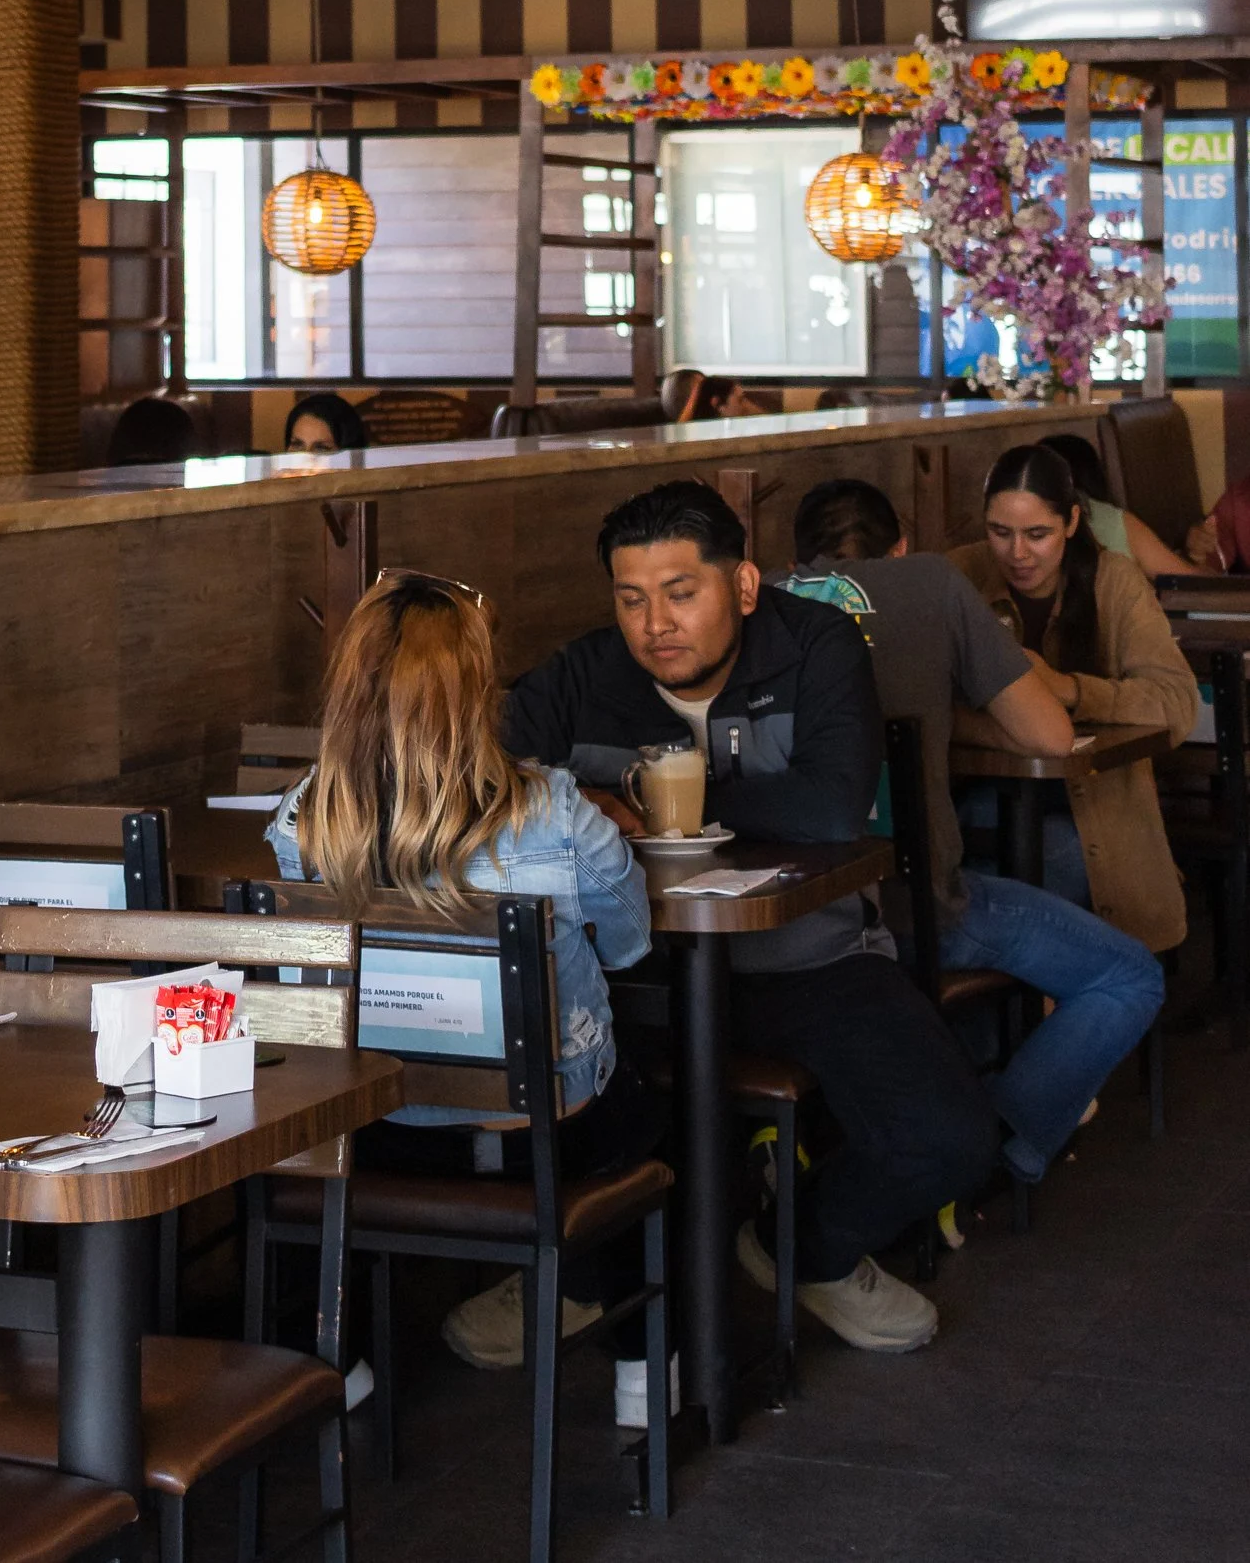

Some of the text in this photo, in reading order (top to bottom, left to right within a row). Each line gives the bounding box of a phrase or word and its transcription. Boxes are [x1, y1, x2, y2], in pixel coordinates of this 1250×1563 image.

[374, 989, 405, 998] AMAMOS
[407, 991, 435, 1001] PORQUE
[436, 992, 444, 1001] ÉL
[373, 1001, 390, 1009] AMÓ
[391, 1002, 424, 1011] PRIMERO.
